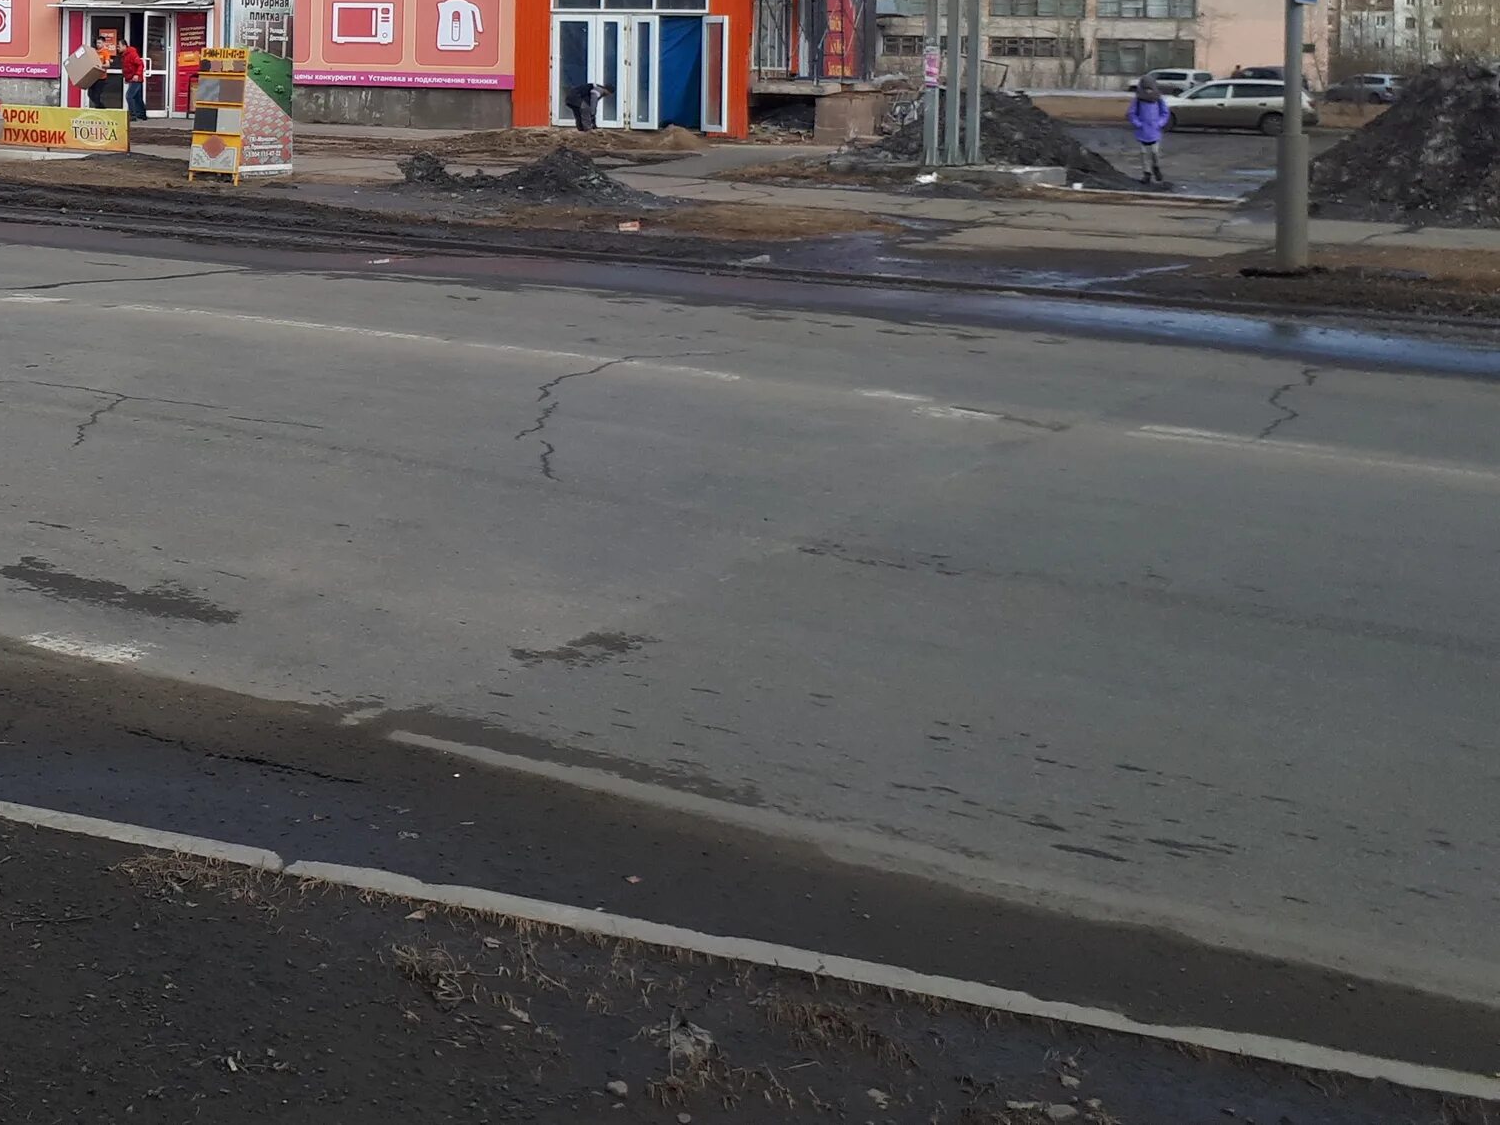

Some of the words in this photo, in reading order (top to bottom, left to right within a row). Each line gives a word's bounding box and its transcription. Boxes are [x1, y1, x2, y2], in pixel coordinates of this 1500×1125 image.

[250, 11, 280, 21] плитка
[4, 128, 66, 144] ПУХОВИК
[72, 126, 117, 141] ТОЧКА
